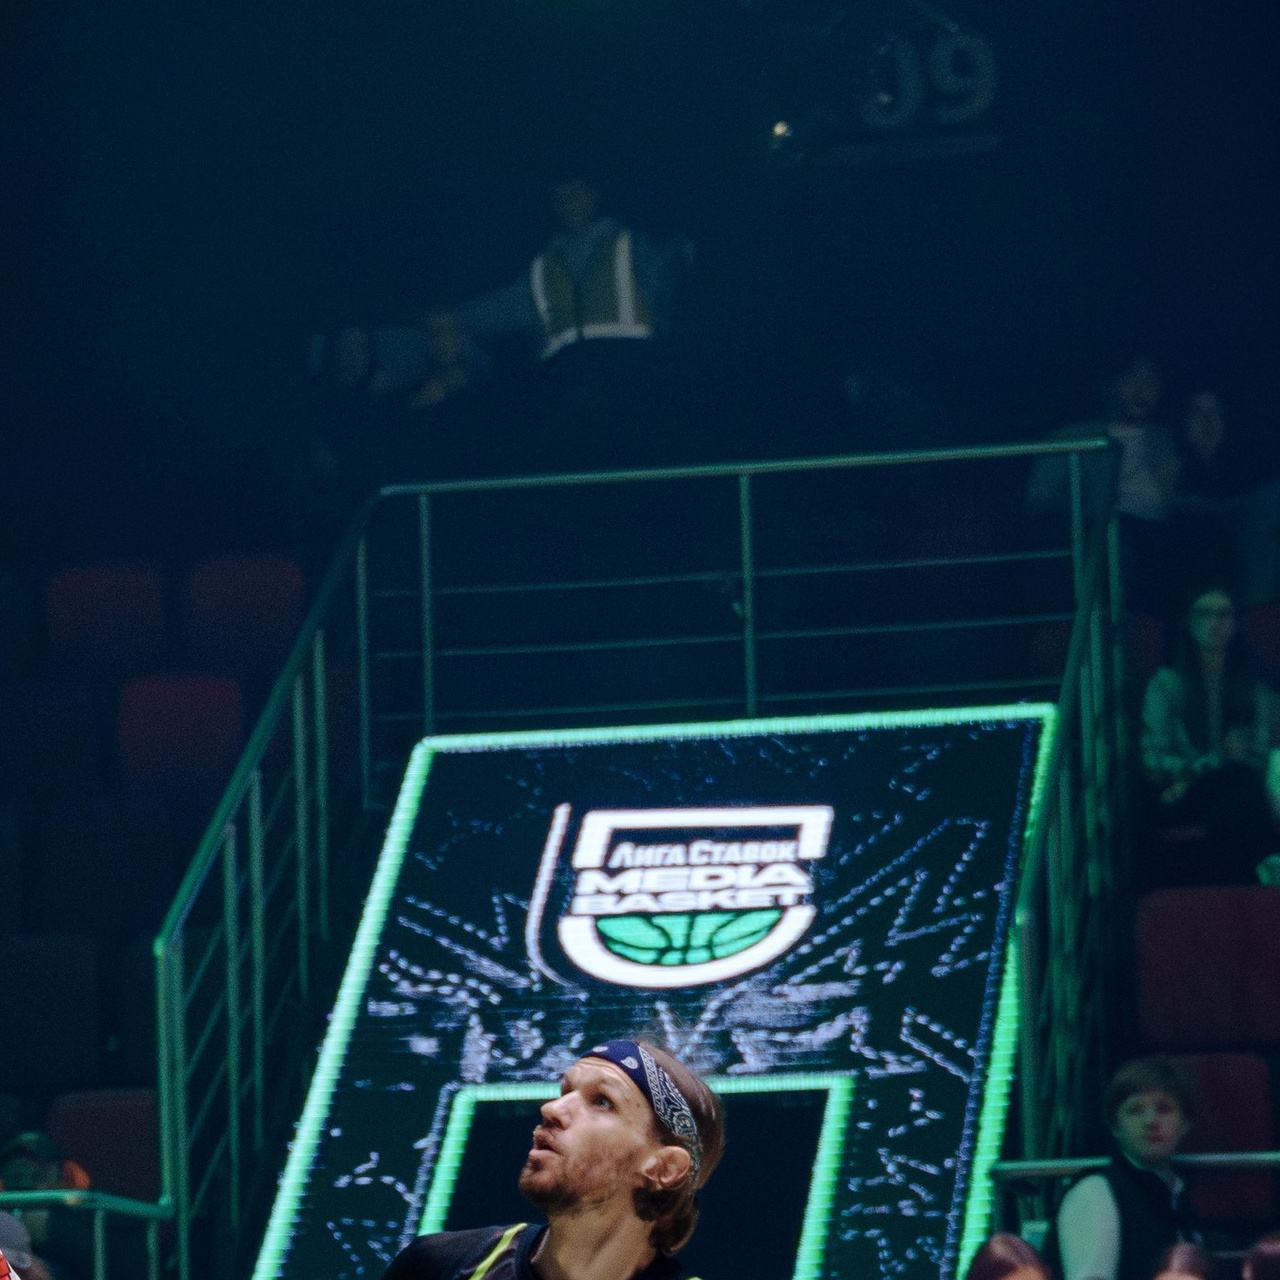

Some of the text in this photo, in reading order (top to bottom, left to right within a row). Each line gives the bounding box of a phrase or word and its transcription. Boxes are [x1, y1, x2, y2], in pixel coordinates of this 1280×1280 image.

[608, 839, 799, 869] ЛИГА СТАВОК
[576, 863, 812, 896] MEDIA
[571, 888, 812, 916] BASKET
